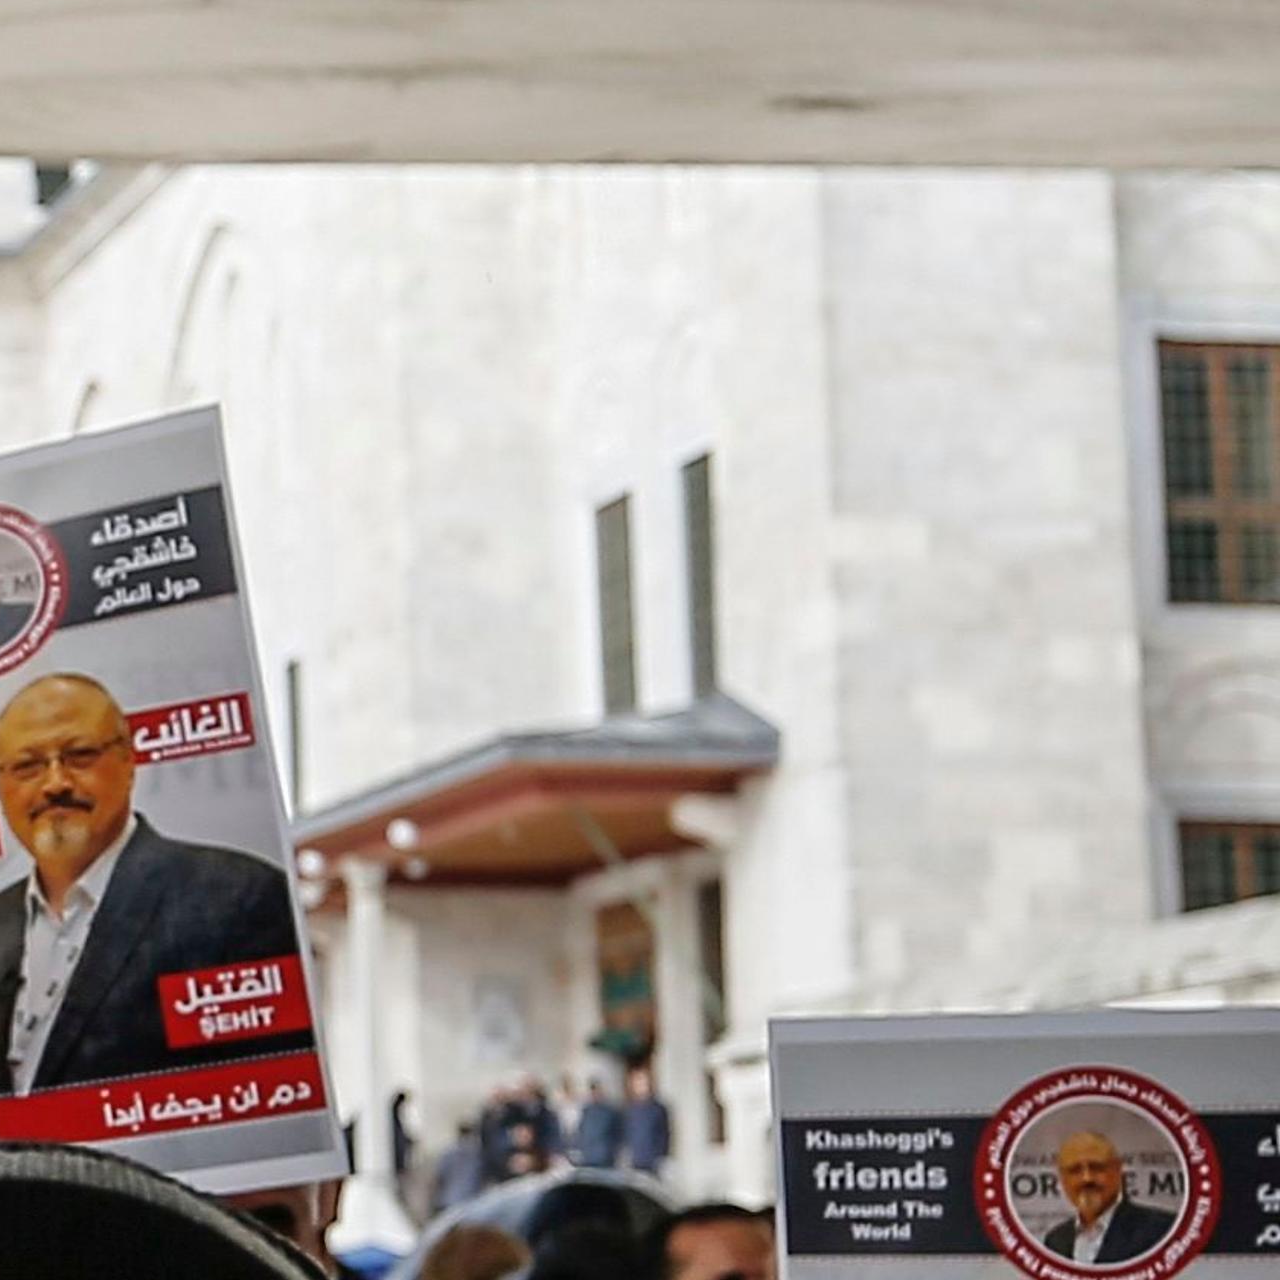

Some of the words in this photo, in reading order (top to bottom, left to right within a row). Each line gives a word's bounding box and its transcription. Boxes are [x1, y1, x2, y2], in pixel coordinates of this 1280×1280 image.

[92, 535, 197, 589] خاشقجي
[94, 581, 153, 616] العالم
[156, 577, 200, 601] حول
[133, 700, 243, 761] الغائب
[174, 965, 283, 1015] القتيل
[151, 1093, 222, 1123] يجف
[229, 1081, 260, 1112] لن
[268, 1081, 312, 1109] دم
[805, 1129, 954, 1152] Khashoggi's
[814, 1161, 948, 1191] friends
[824, 1202, 898, 1219] Around
[903, 1202, 943, 1218] The
[852, 1223, 911, 1241] World
